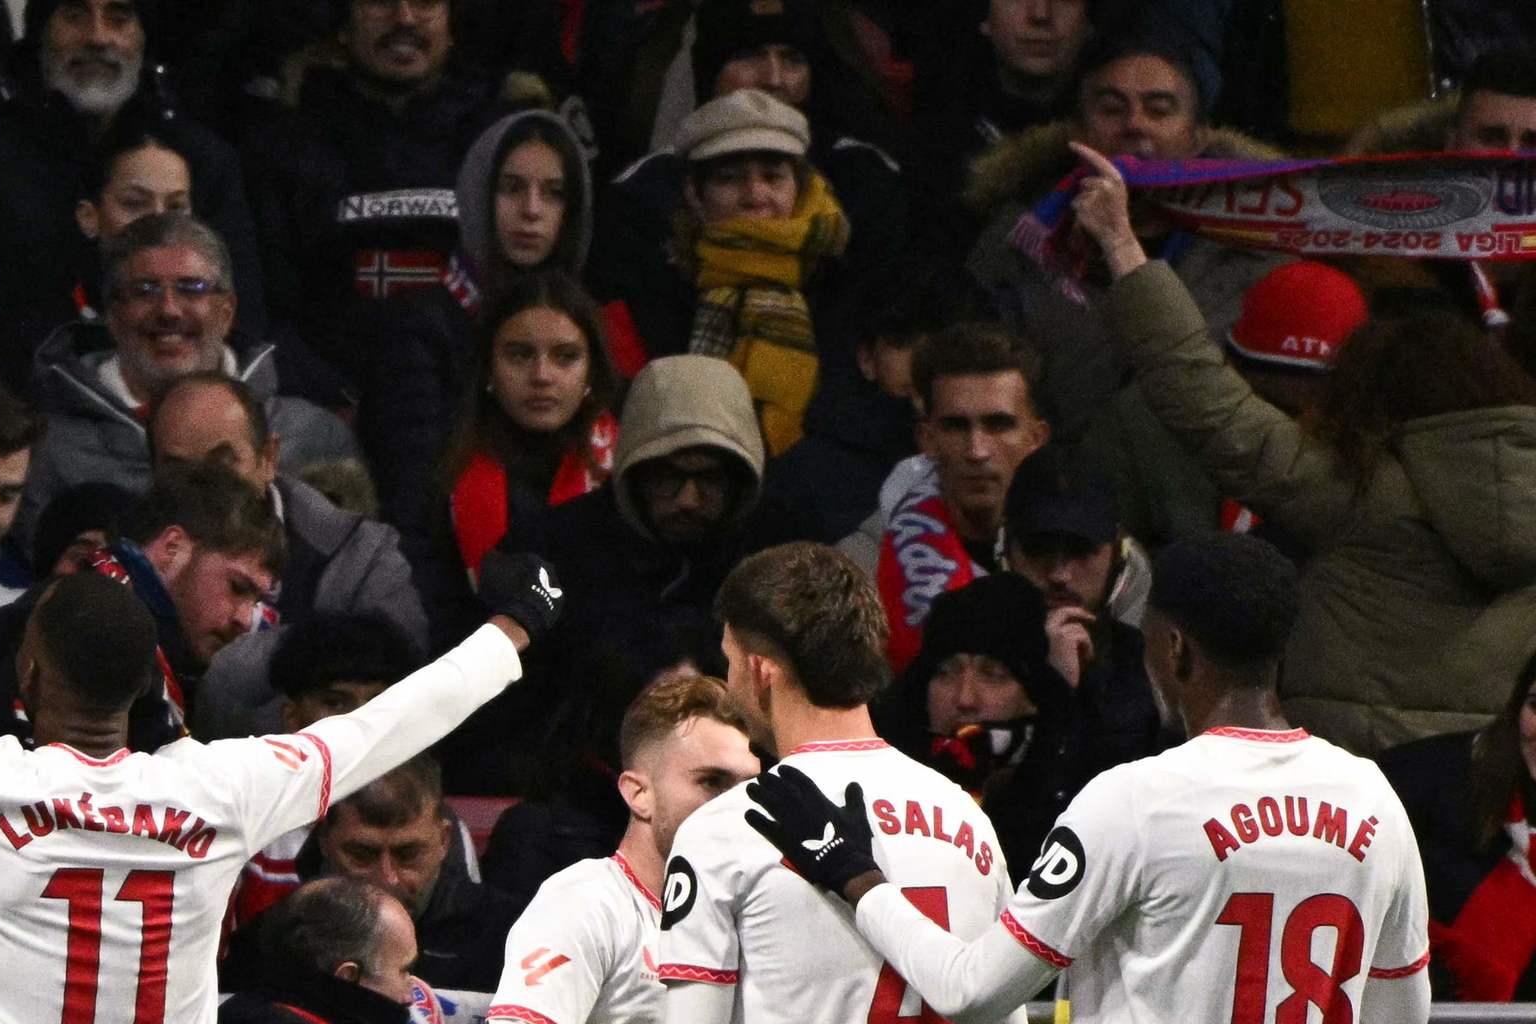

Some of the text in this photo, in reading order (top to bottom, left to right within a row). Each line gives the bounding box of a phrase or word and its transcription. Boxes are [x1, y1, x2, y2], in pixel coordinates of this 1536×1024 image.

[1276, 230, 1522, 253] LIGA 2024-2025
[872, 799, 994, 876] SALAS
[1202, 795, 1381, 863] AGOUMÉ
